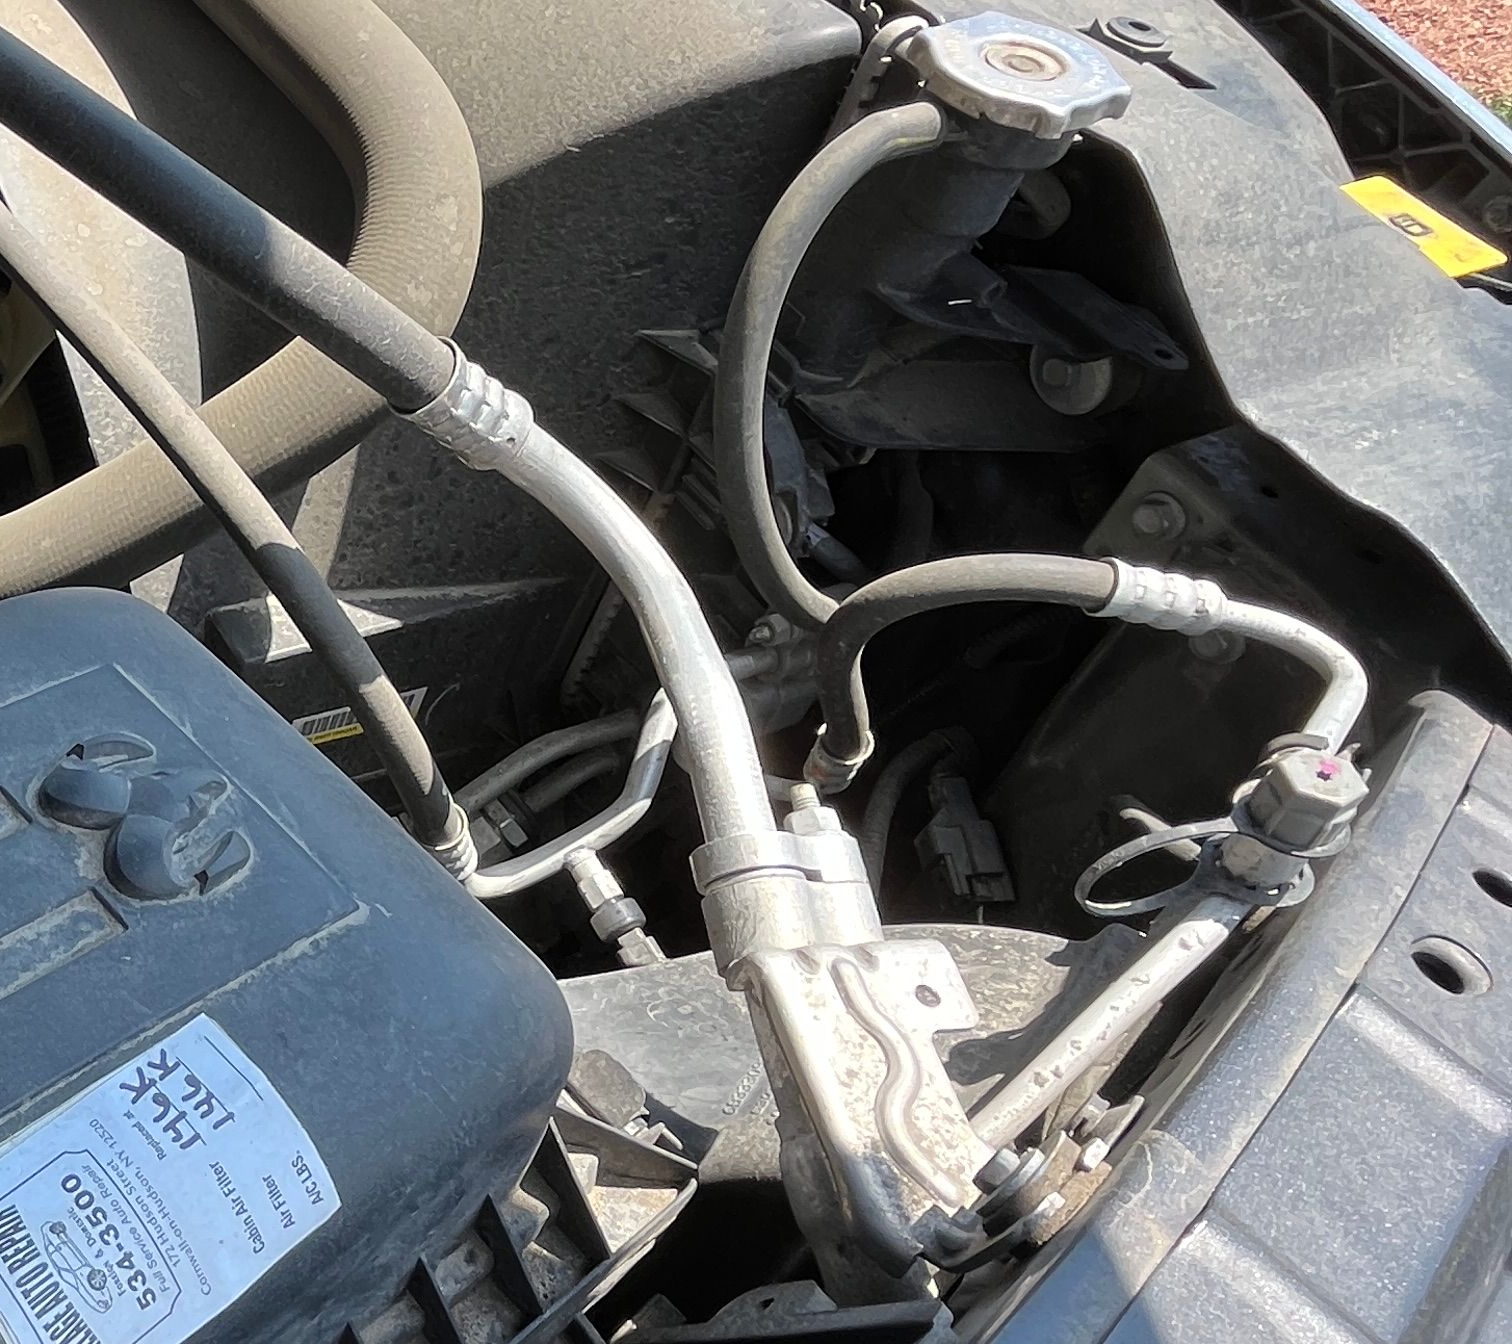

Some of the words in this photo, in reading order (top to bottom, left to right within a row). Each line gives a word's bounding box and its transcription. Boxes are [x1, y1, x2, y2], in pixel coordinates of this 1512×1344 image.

[122, 1109, 135, 1120] at
[88, 1118, 118, 1149] 12520
[130, 1120, 168, 1161] Replaced
[114, 1149, 134, 1168] NY
[80, 1164, 113, 1200] Repair
[105, 1158, 137, 1196] Street
[208, 1161, 237, 1199] Filter
[261, 1174, 287, 1211] Filter
[305, 1180, 325, 1206] A/C
[109, 1198, 133, 1225] Auto
[134, 1194, 170, 1246] Hudson
[230, 1195, 249, 1217] Air
[280, 1208, 296, 1230] Air
[60, 1173, 157, 1311] 534-3500
[128, 1226, 158, 1270] Service
[243, 1214, 266, 1255] Cabin
[164, 1244, 181, 1268] 172
[14, 1261, 69, 1321] AUTO
[152, 1270, 171, 1293] Full
